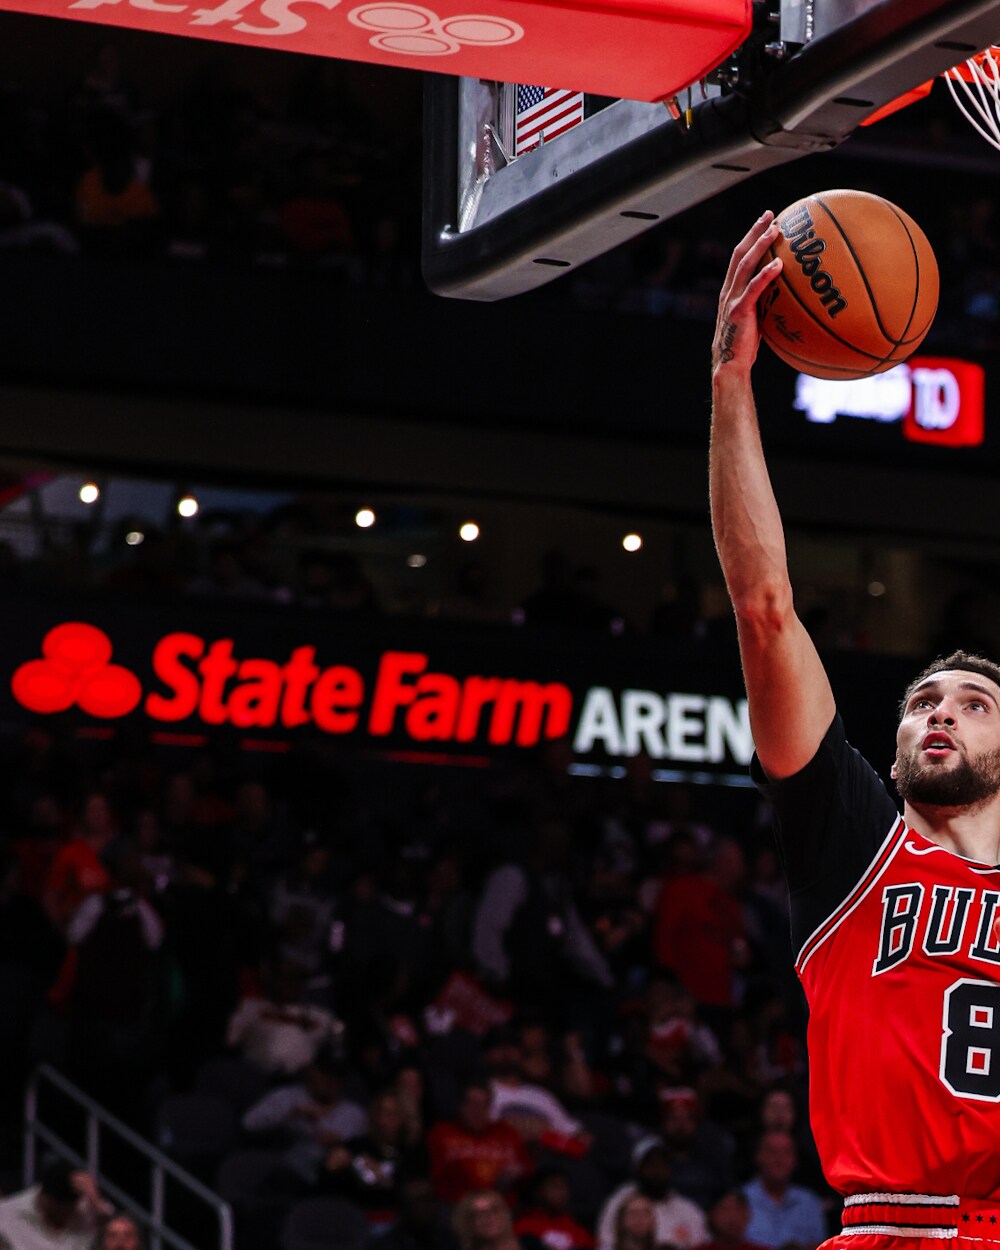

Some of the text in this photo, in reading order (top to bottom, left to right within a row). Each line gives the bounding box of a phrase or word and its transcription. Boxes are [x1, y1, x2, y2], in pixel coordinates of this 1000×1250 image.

[778, 205, 848, 320] Wilson
[145, 630, 753, 767] State Farm AREN
